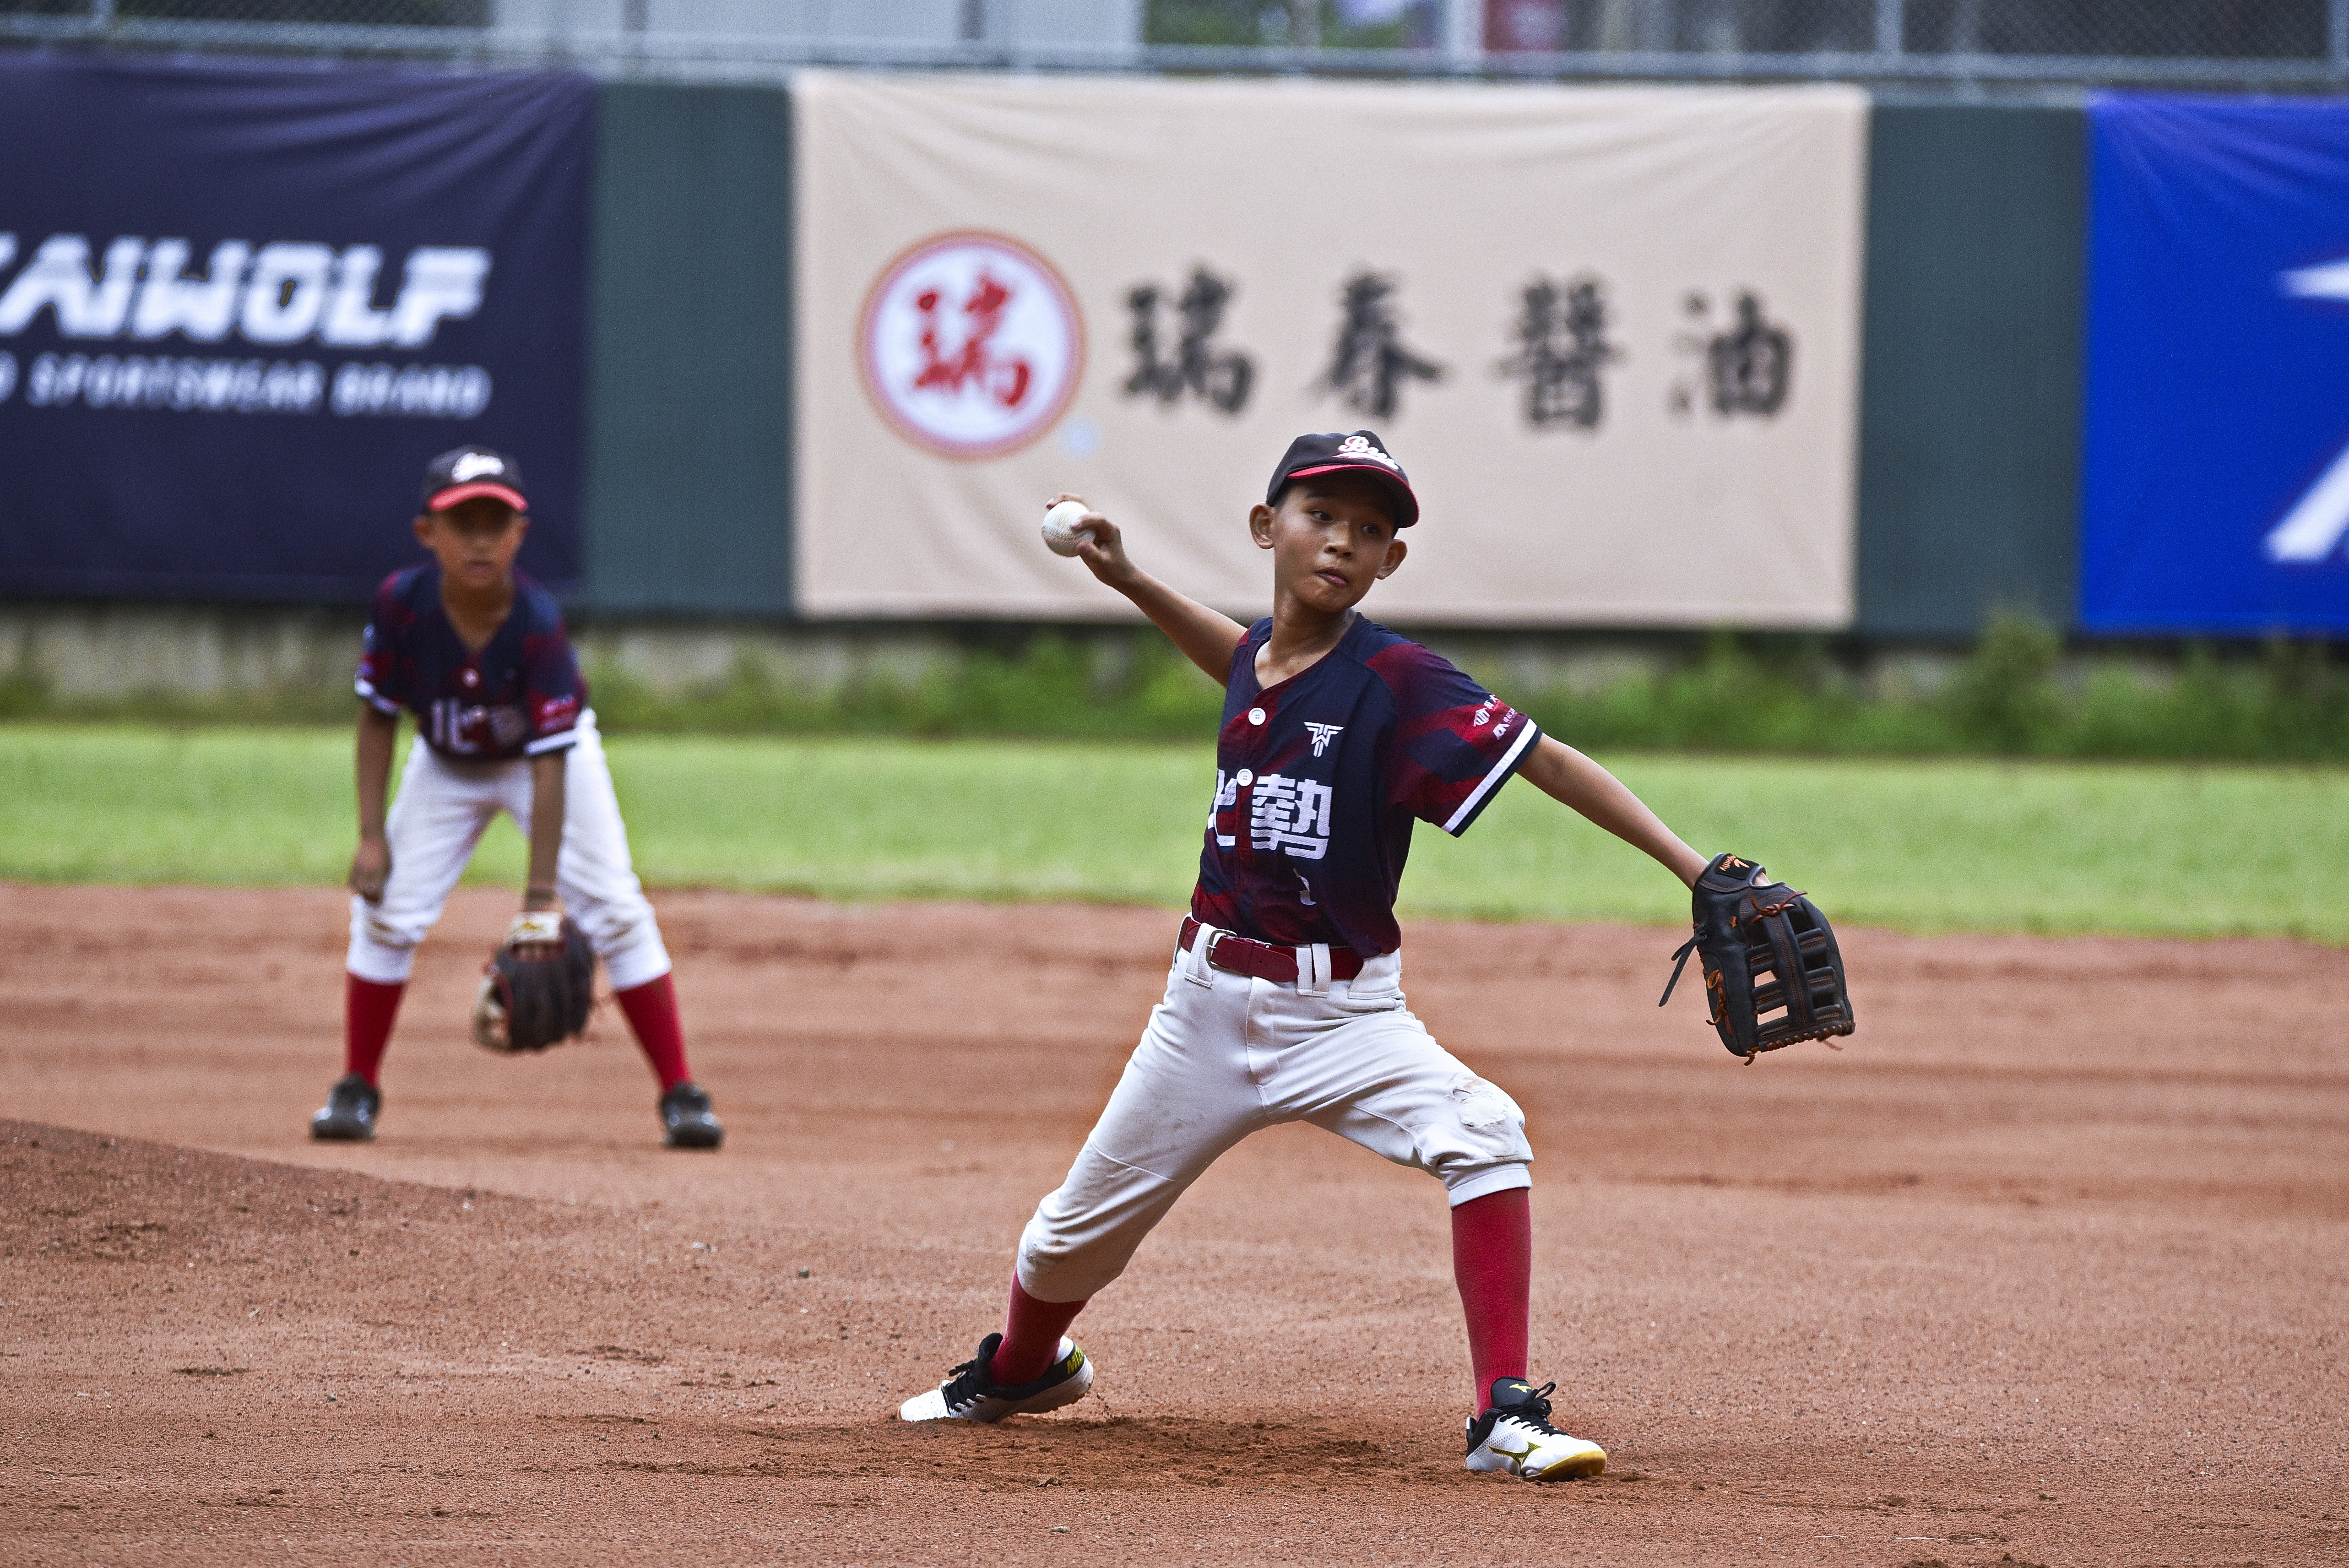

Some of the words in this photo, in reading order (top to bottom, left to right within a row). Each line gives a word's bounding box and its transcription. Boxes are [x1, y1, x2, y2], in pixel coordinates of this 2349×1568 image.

[0, 233, 491, 348] AIWOLF
[27, 353, 326, 410] SPORTSWEAR
[331, 363, 493, 418] BRAND
